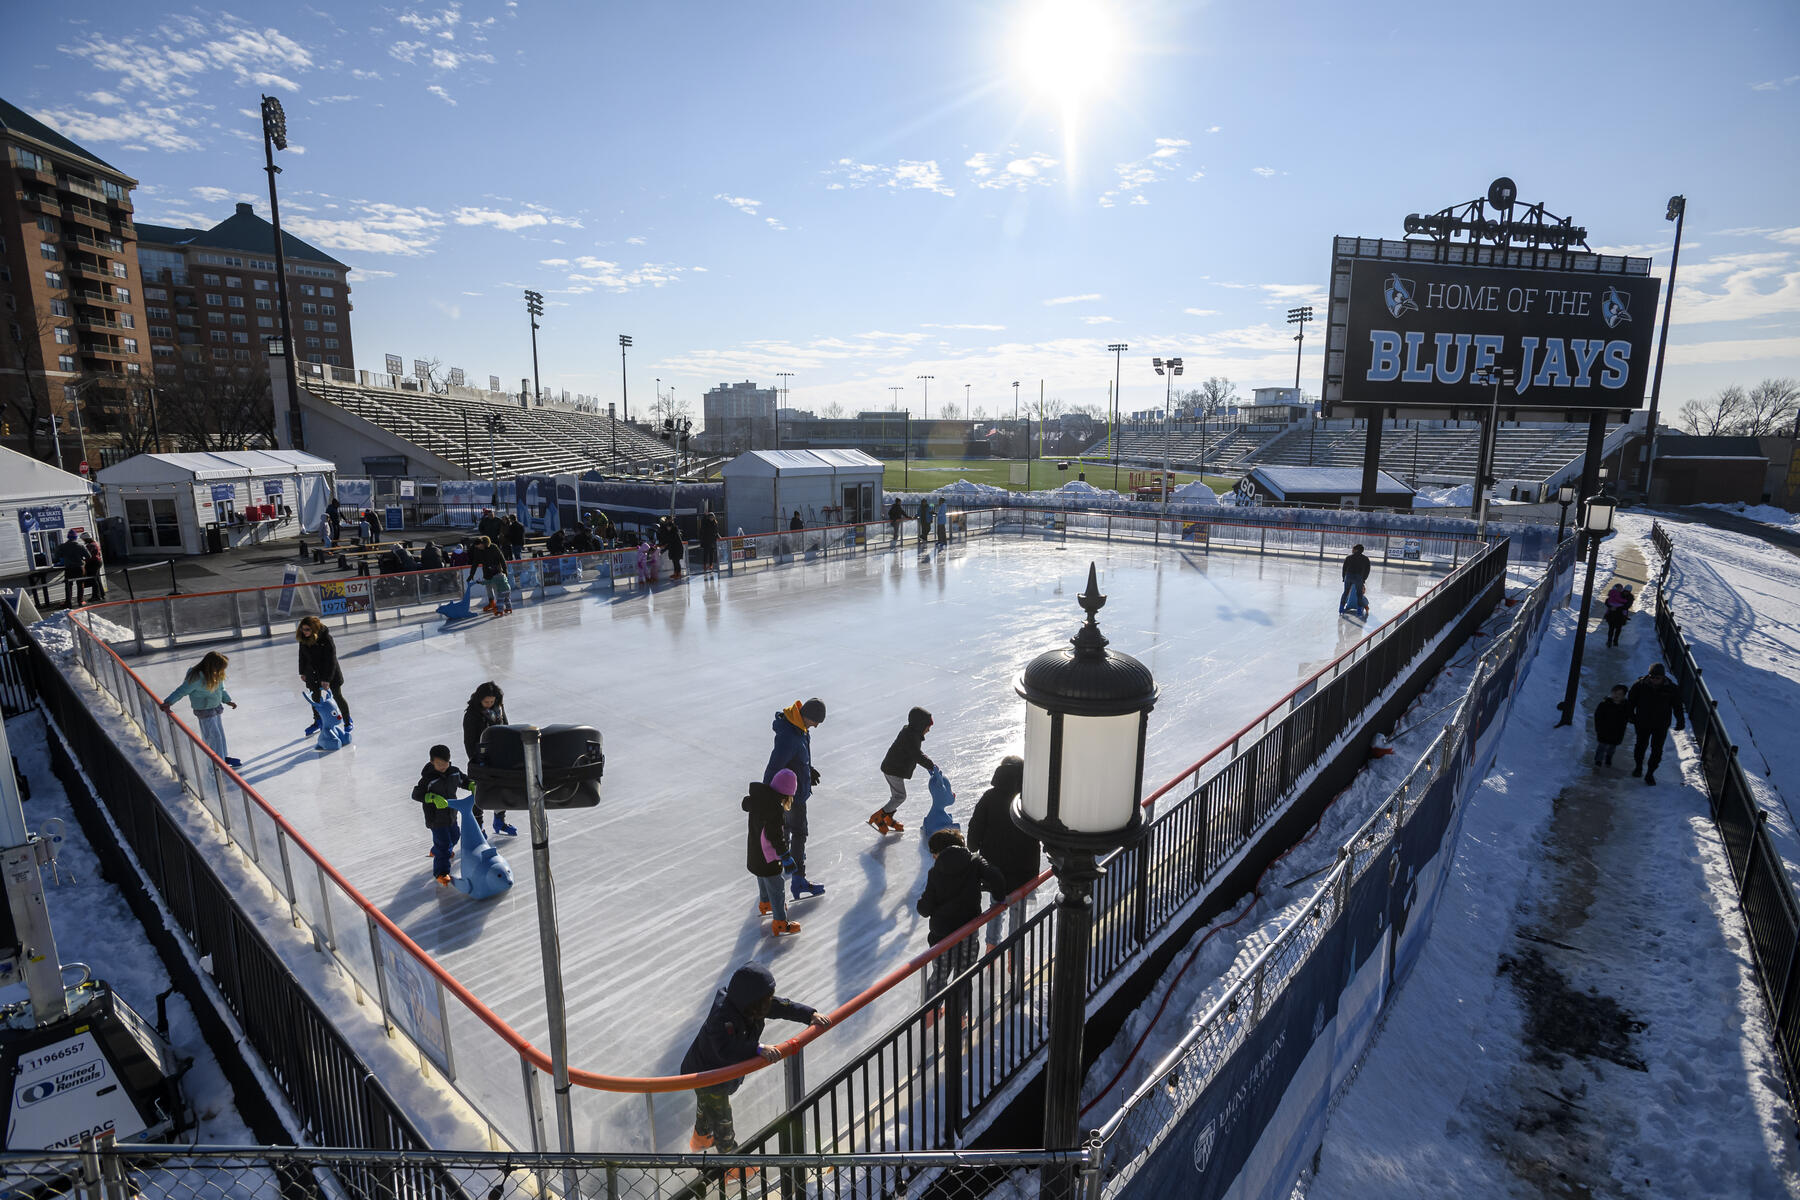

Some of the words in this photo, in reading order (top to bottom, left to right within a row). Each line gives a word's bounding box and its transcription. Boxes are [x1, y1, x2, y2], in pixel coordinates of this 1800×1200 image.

[1426, 282, 1500, 312] HOME
[1507, 287, 1539, 313] OF
[1545, 289, 1592, 316] THE
[1366, 329, 1505, 387] BLUE
[1515, 336, 1632, 396] JAYS
[1240, 477, 1256, 498] GO
[346, 582, 368, 593] 1971
[30, 1042, 84, 1070] 11966557
[55, 1063, 96, 1084] United
[56, 1071, 101, 1092] Rentals
